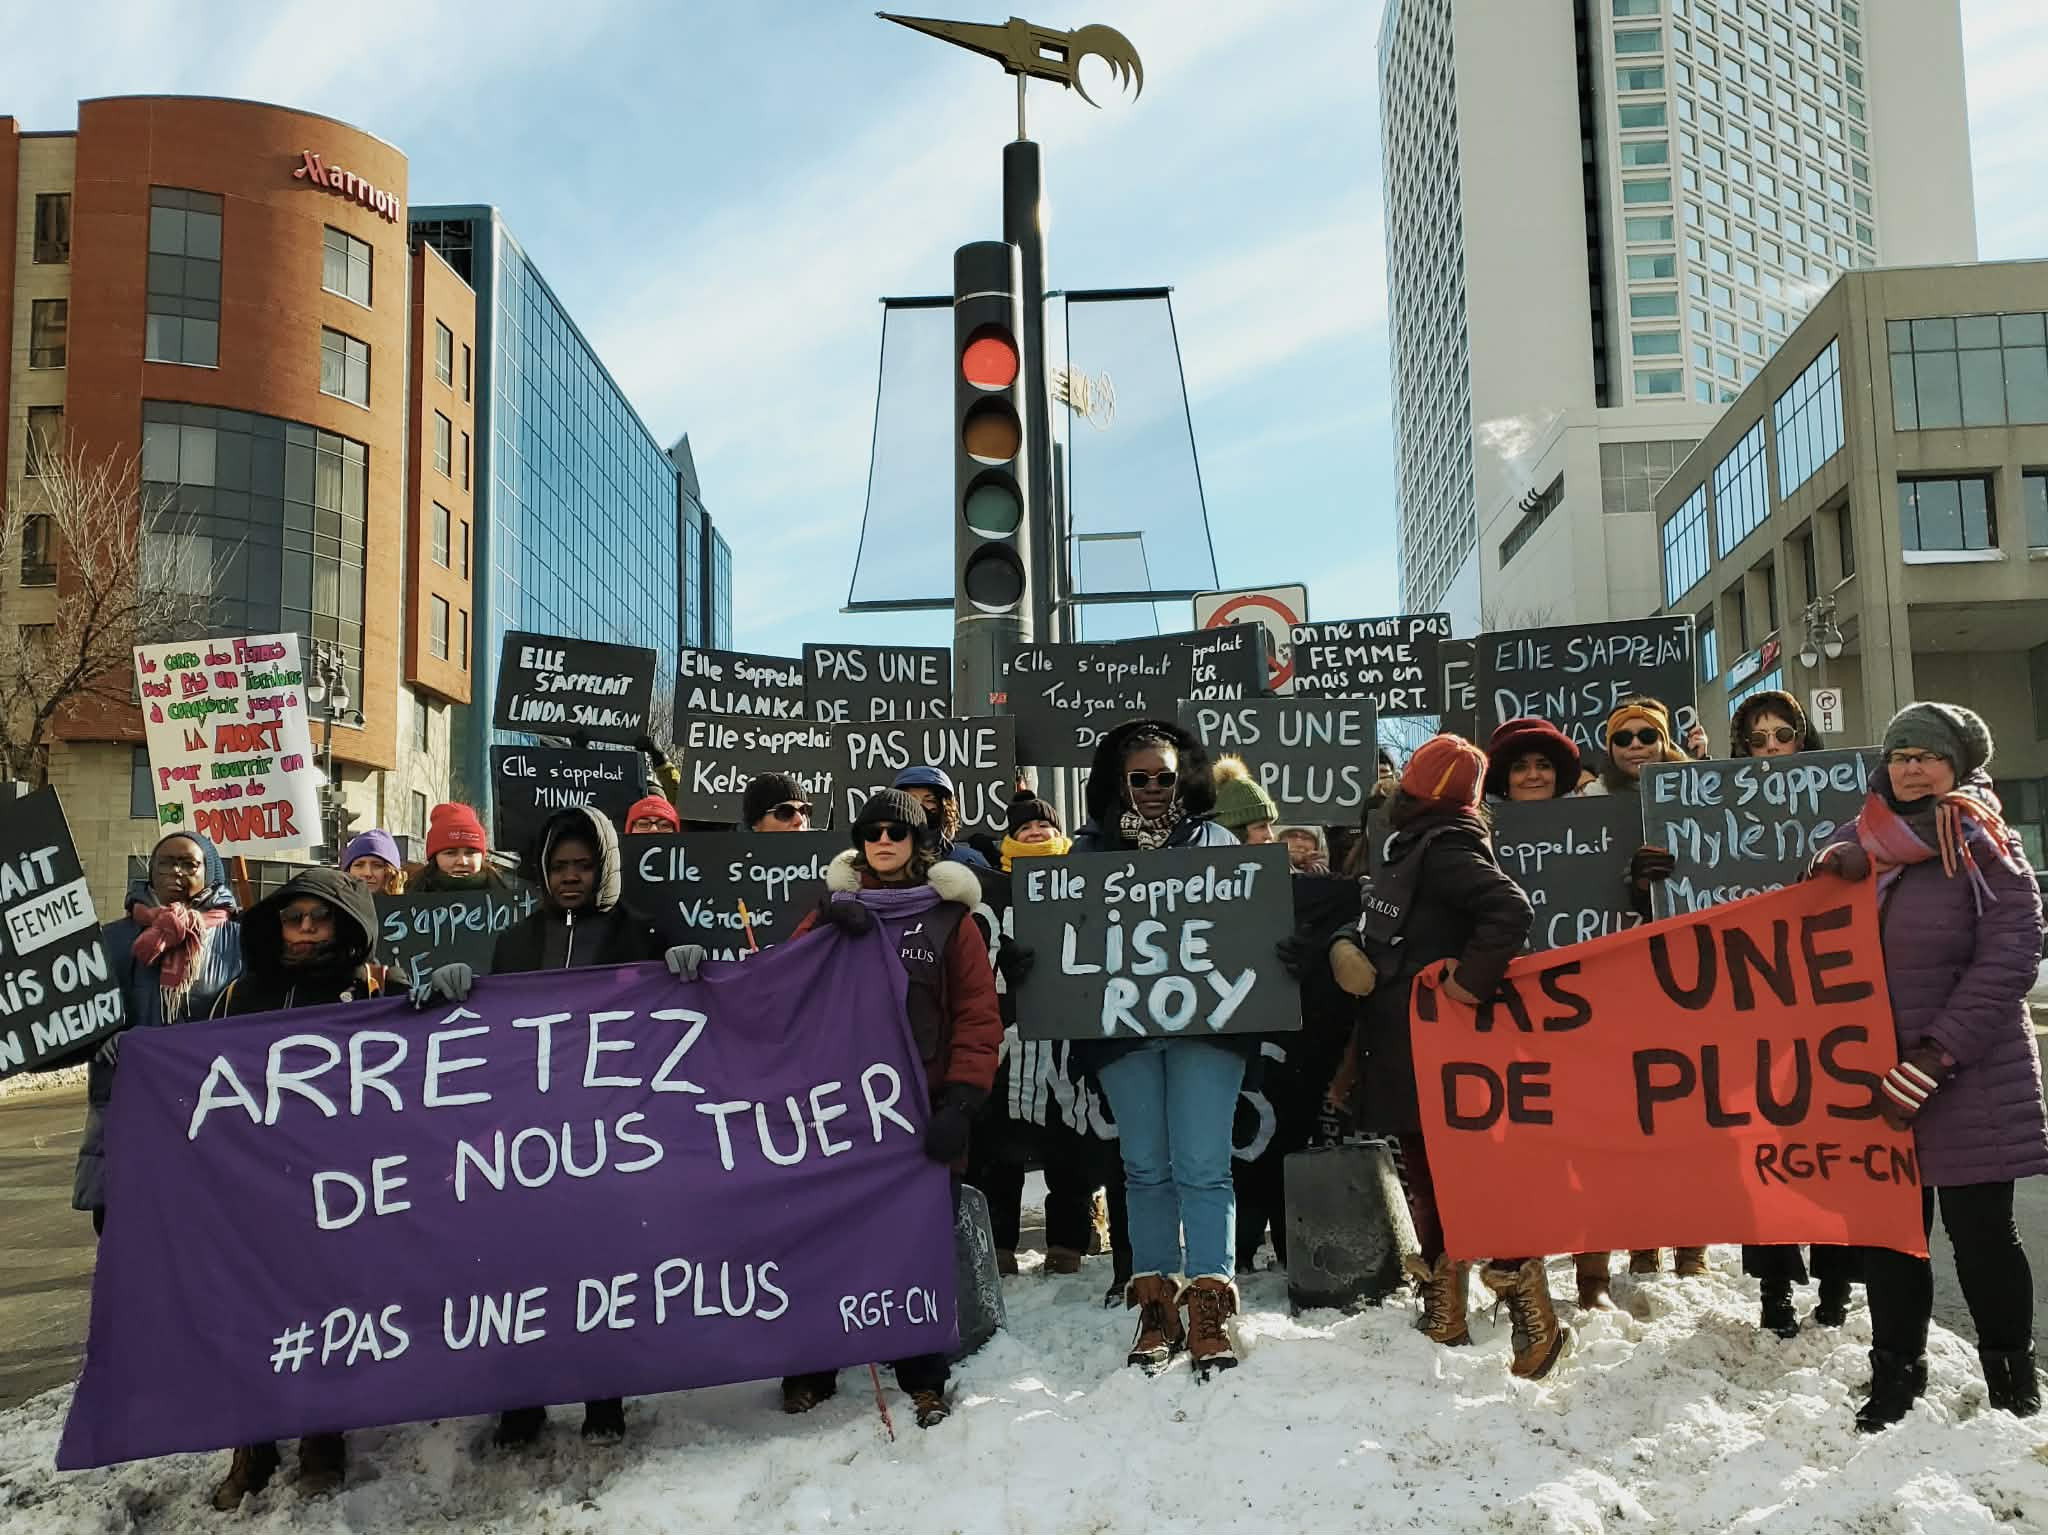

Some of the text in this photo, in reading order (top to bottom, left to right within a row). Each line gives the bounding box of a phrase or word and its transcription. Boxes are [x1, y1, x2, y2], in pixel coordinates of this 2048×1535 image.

[293, 150, 400, 223] Marriott
[1324, 623, 1352, 641] ne
[1409, 617, 1449, 642] pas
[204, 644, 232, 666] des
[520, 646, 566, 672] ELLE
[680, 650, 723, 681] Elle
[815, 649, 938, 685] PAS UNE
[1014, 650, 1171, 685] Elle s'appelait
[1310, 644, 1418, 670] FEMME,
[180, 672, 208, 695] PAS
[214, 671, 238, 689] un
[1294, 666, 1422, 691] mais on en
[150, 702, 163, 723] à
[1196, 708, 1362, 747] PAS UNE
[184, 719, 283, 754] LA MORT
[688, 722, 739, 749] Elle
[847, 728, 998, 770] PAS UNE
[159, 754, 304, 790] pour nourrir un
[502, 755, 624, 787] Elle s'appelait
[1259, 762, 1362, 807] PLUS
[1655, 767, 1723, 806] Elle
[189, 778, 266, 804] besoin de
[193, 800, 300, 844] POUVOIR
[639, 847, 702, 882] Elle
[1028, 868, 1086, 901] Elle
[10, 889, 83, 943] FEMME
[52, 941, 108, 993] ON
[901, 948, 935, 963] PLUS
[1650, 905, 1875, 1011] UNE
[1101, 968, 1257, 1037] ROY
[31, 988, 121, 1056] MEURT
[1442, 1061, 1553, 1131] DE
[1633, 1025, 1886, 1135] PLUS
[312, 1155, 411, 1231] DE
[455, 1112, 664, 1201] NOUS
[696, 1063, 915, 1170] TUER
[1755, 1143, 1916, 1186] RGF-CN
[270, 1258, 789, 1372] #PAS UNE DE PLUS
[839, 1287, 938, 1333] RGF-CN
